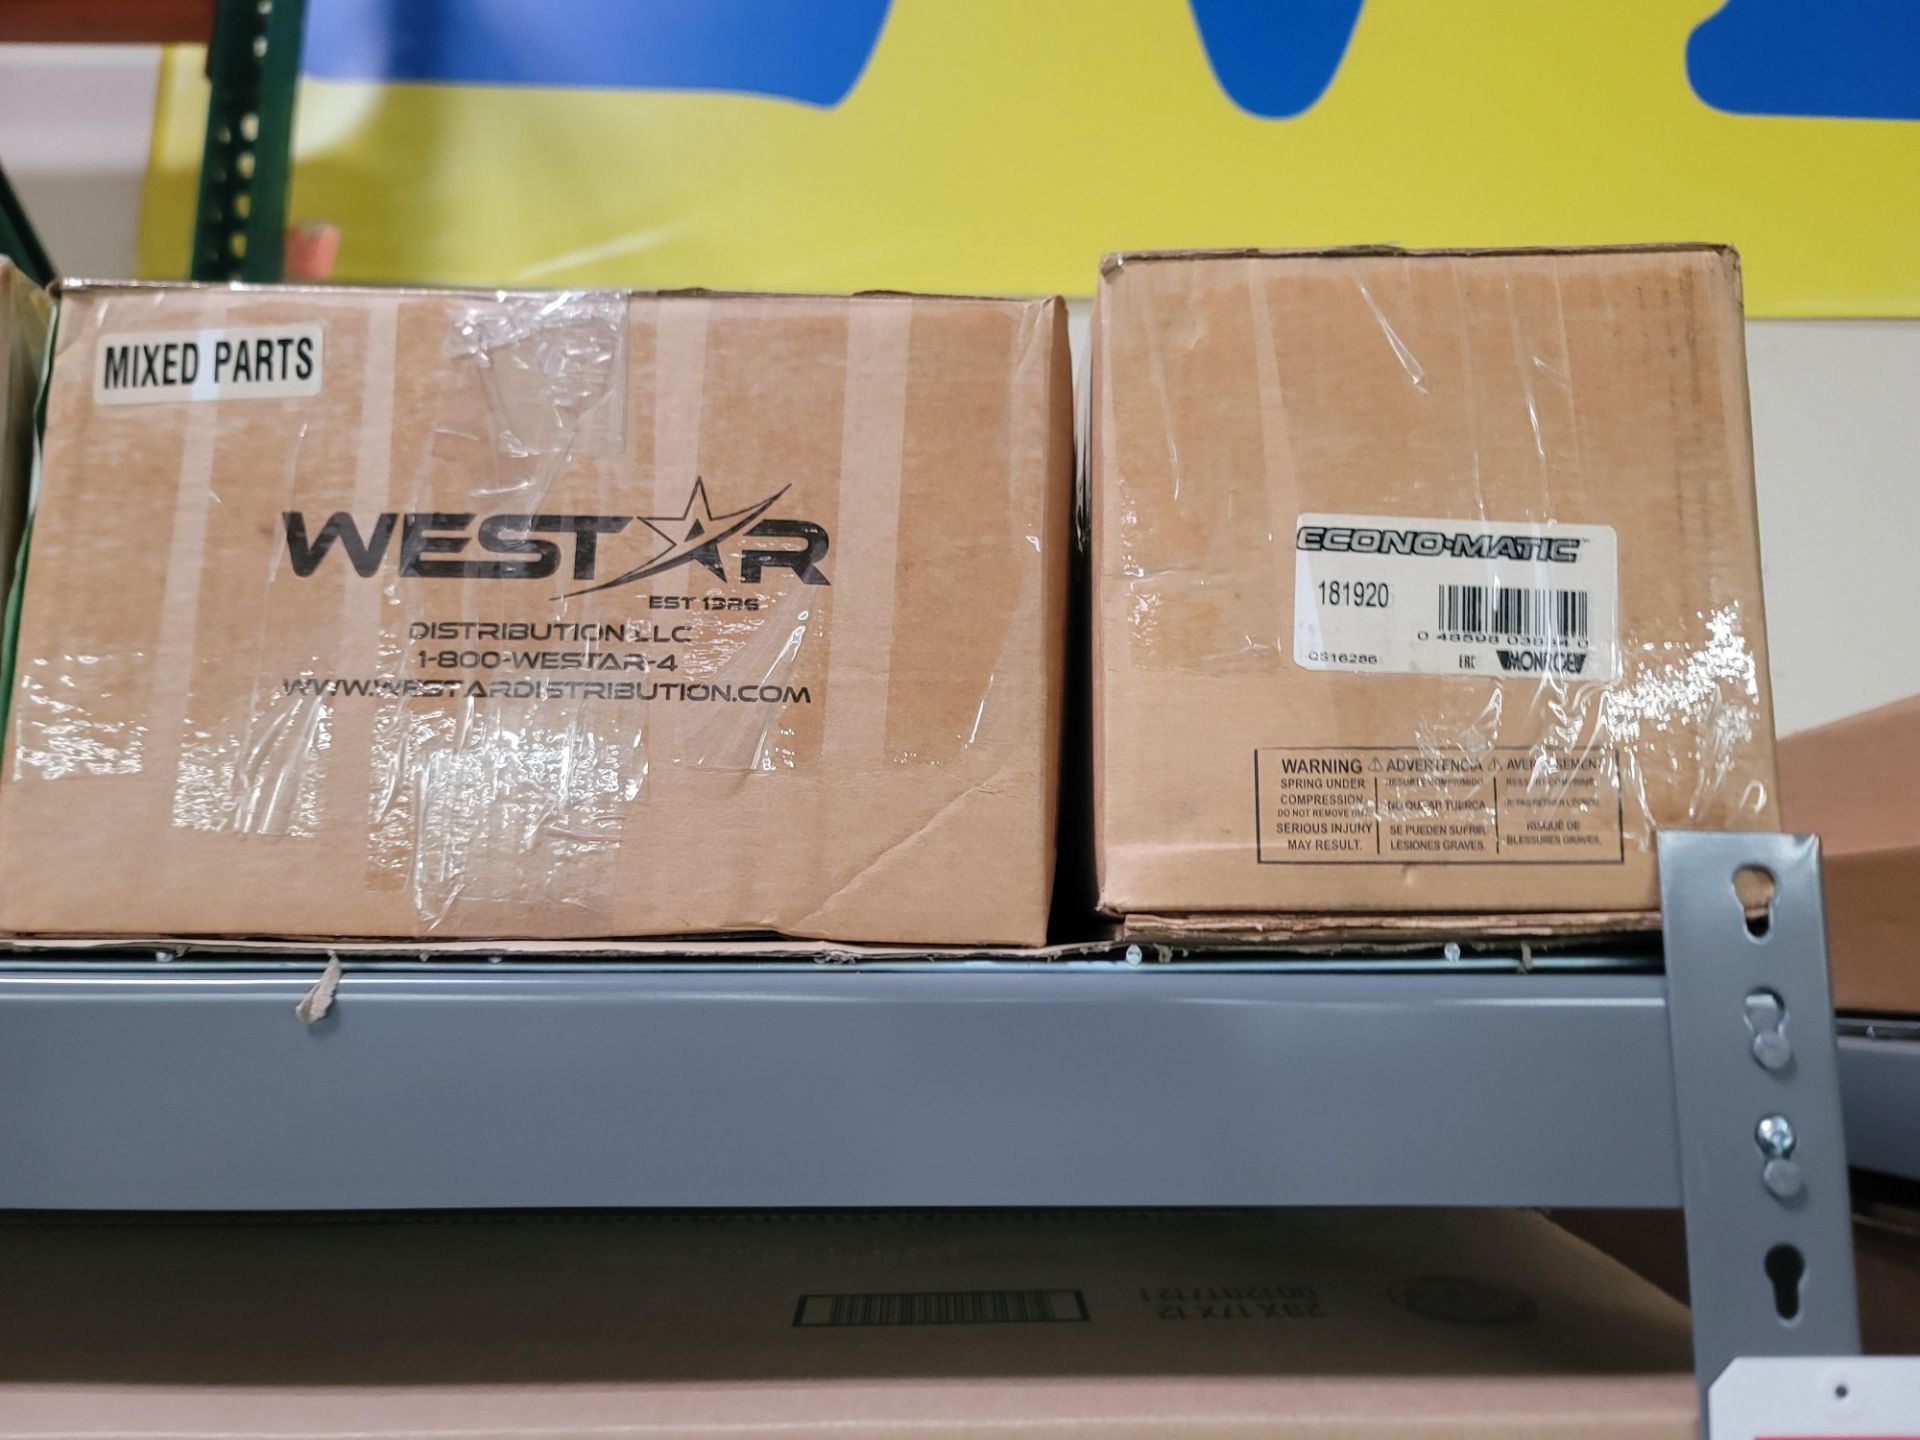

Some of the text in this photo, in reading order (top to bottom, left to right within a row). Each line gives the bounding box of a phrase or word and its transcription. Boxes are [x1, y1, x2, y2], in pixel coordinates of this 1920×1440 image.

[103, 337, 315, 389] MIXED PARTS
[1318, 580, 1389, 608] 181920
[649, 596, 696, 610] EST
[408, 622, 625, 642] DISTRIBUTION
[418, 651, 679, 672] 1-800-WESTAR-4
[284, 678, 812, 704] WWW.WESTARDISTRIBUTION.COM
[1281, 758, 1363, 774] WARNING
[1387, 758, 1483, 772] ADVERTENCIA
[1280, 779, 1365, 789] SPRING UNDER
[1280, 794, 1364, 805] COMPRESSION
[1277, 809, 1290, 817] DO
[1292, 809, 1310, 817] NOT
[1312, 809, 1349, 817] REMOVE
[1276, 823, 1373, 834] SERIOUS INJURY
[1287, 840, 1312, 851] MAY
